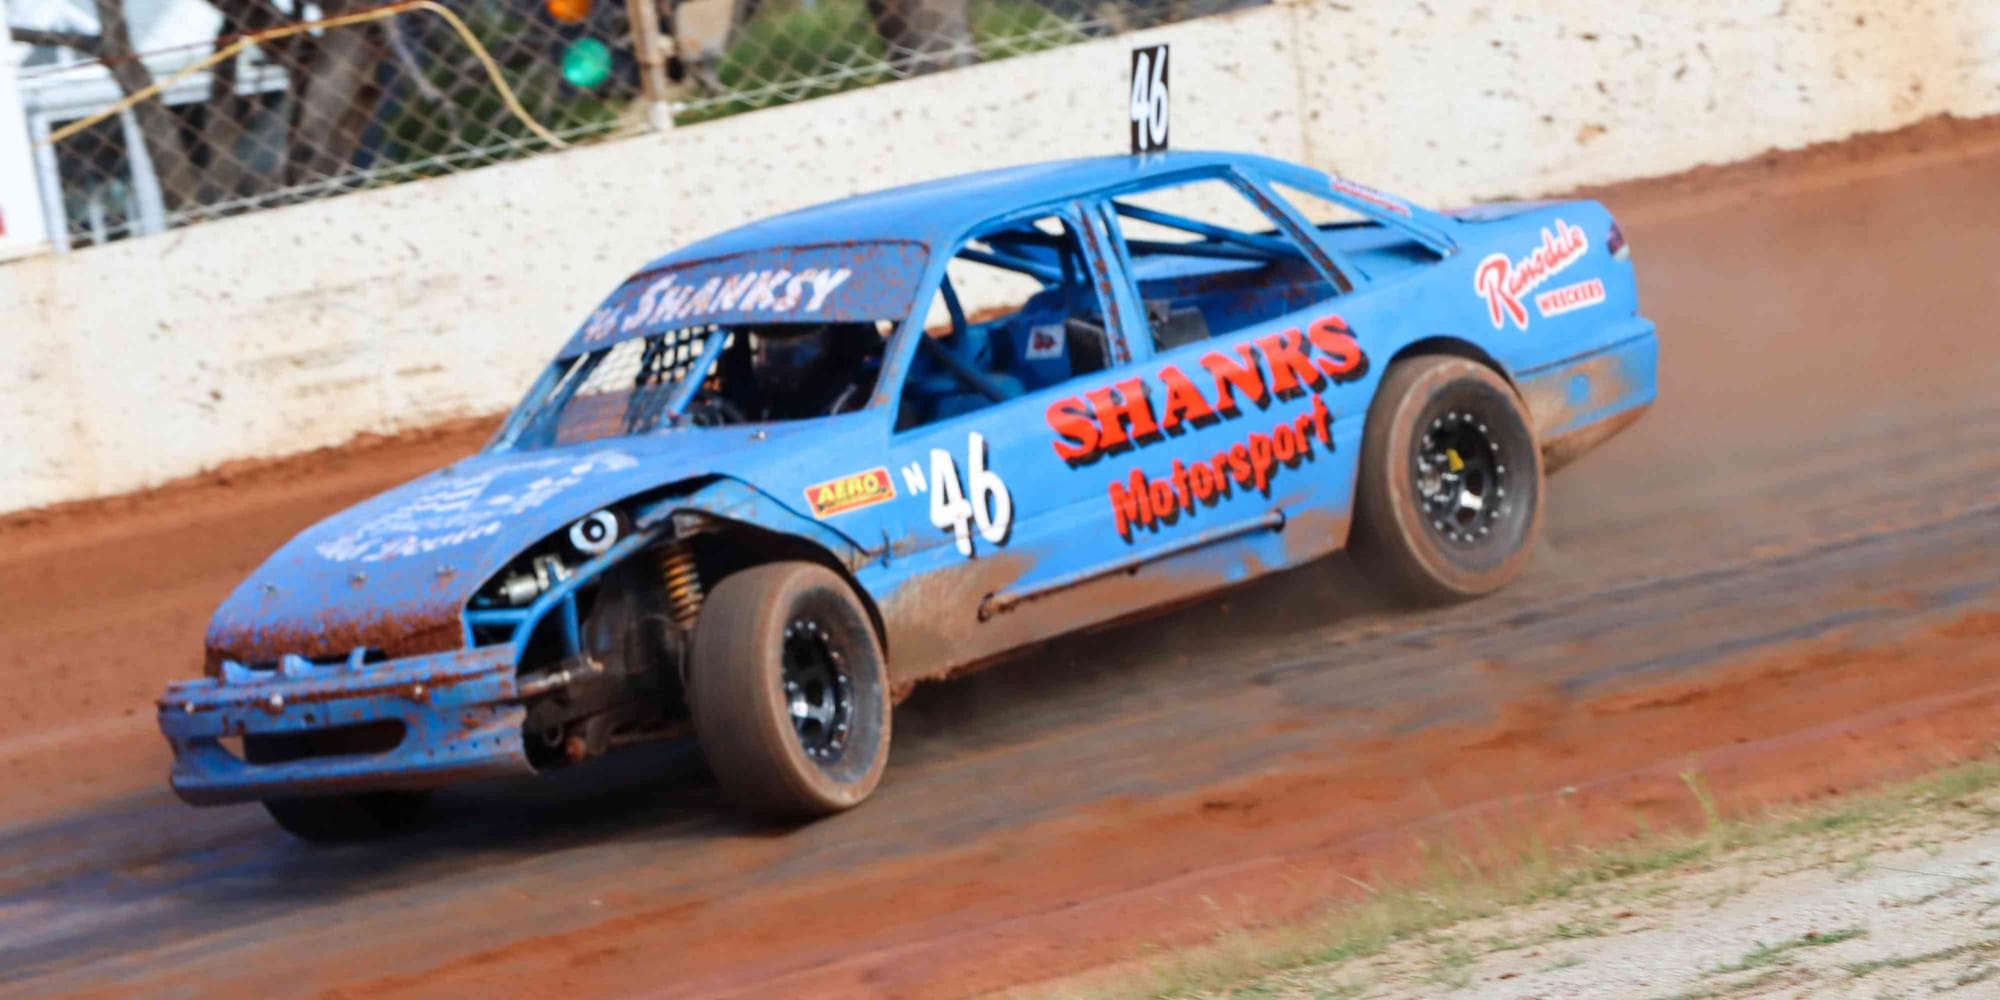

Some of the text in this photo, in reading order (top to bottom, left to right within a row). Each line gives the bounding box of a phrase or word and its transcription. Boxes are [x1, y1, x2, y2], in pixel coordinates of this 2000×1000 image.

[1131, 45, 1168, 151] 46
[620, 269, 852, 333] SHANKSY
[1539, 281, 1604, 313] WRECKERS
[1045, 314, 1367, 467] SHANKS
[817, 472, 879, 506] AERO
[930, 431, 1012, 556] 46
[1108, 393, 1333, 541] Motorsport
